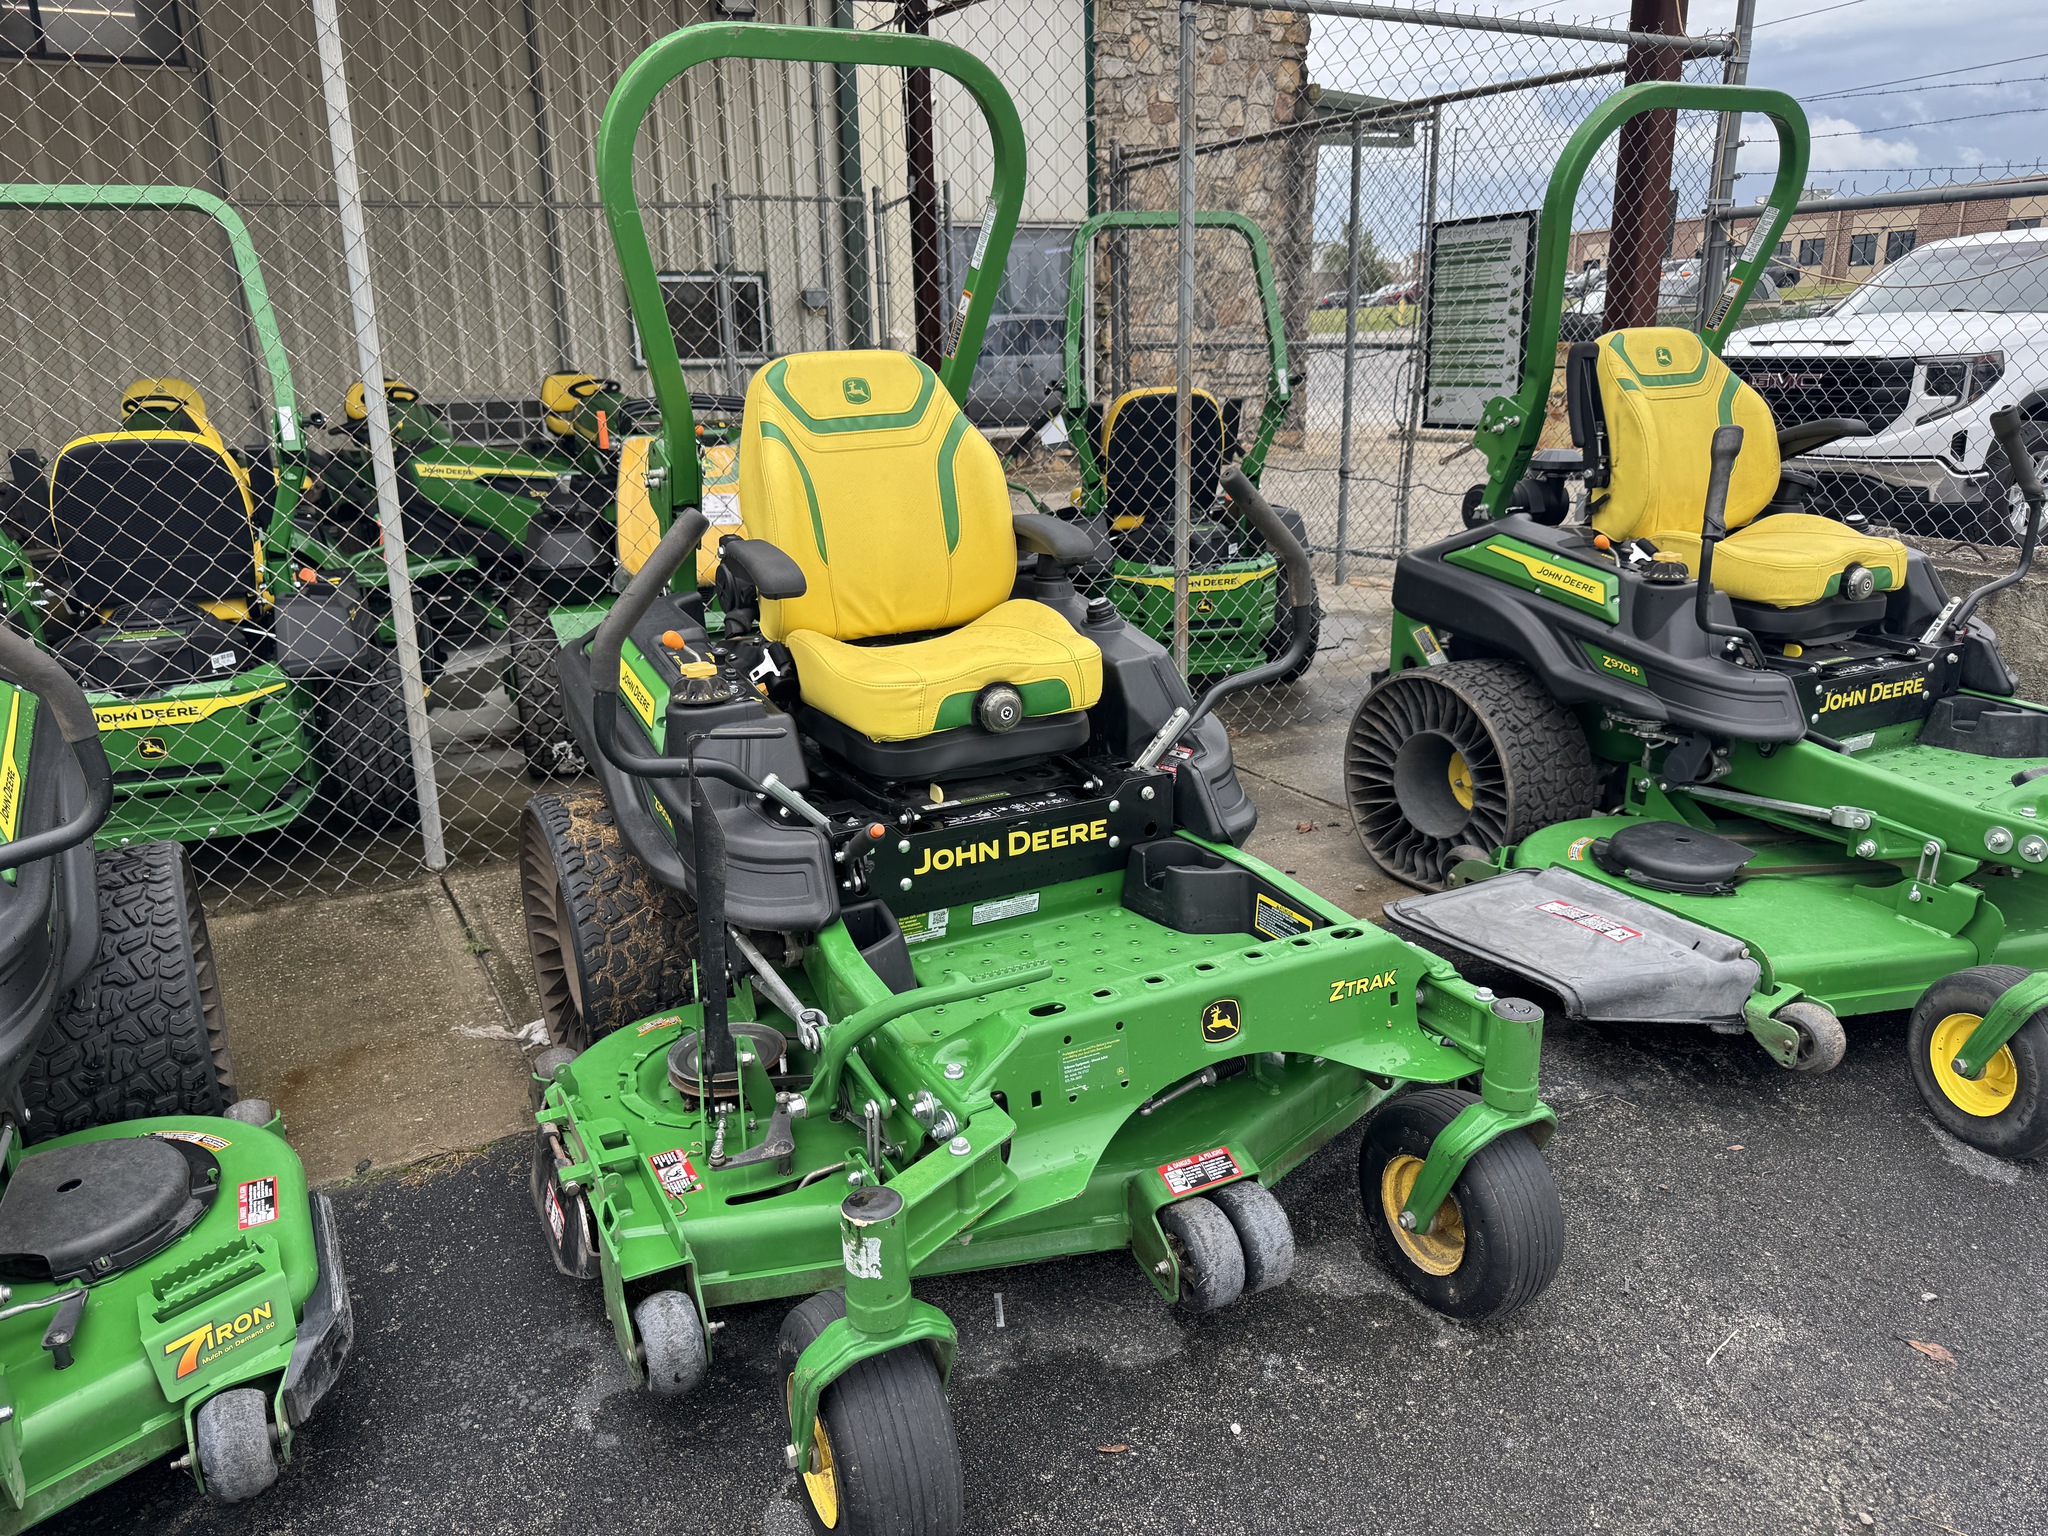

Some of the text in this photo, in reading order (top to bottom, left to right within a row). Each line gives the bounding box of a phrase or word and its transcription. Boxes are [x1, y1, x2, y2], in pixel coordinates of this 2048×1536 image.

[1750, 372, 1823, 389] GMC
[422, 466, 474, 476] JOHN DEERE
[1203, 577, 1237, 587] DEERE
[1537, 566, 1596, 594] JOHN DEERE
[1602, 655, 1639, 677] Z970R
[622, 671, 650, 713] JOHN DEERE
[1819, 677, 1925, 713] JOHN DEERE
[95, 706, 199, 724] JOHN DEERE
[0, 766, 16, 825] JOHN DEERE
[914, 818, 1108, 876] JOHN DEERE
[1329, 968, 1398, 1003] ZTRAK
[202, 1321, 275, 1365] Mulch on Demand 60
